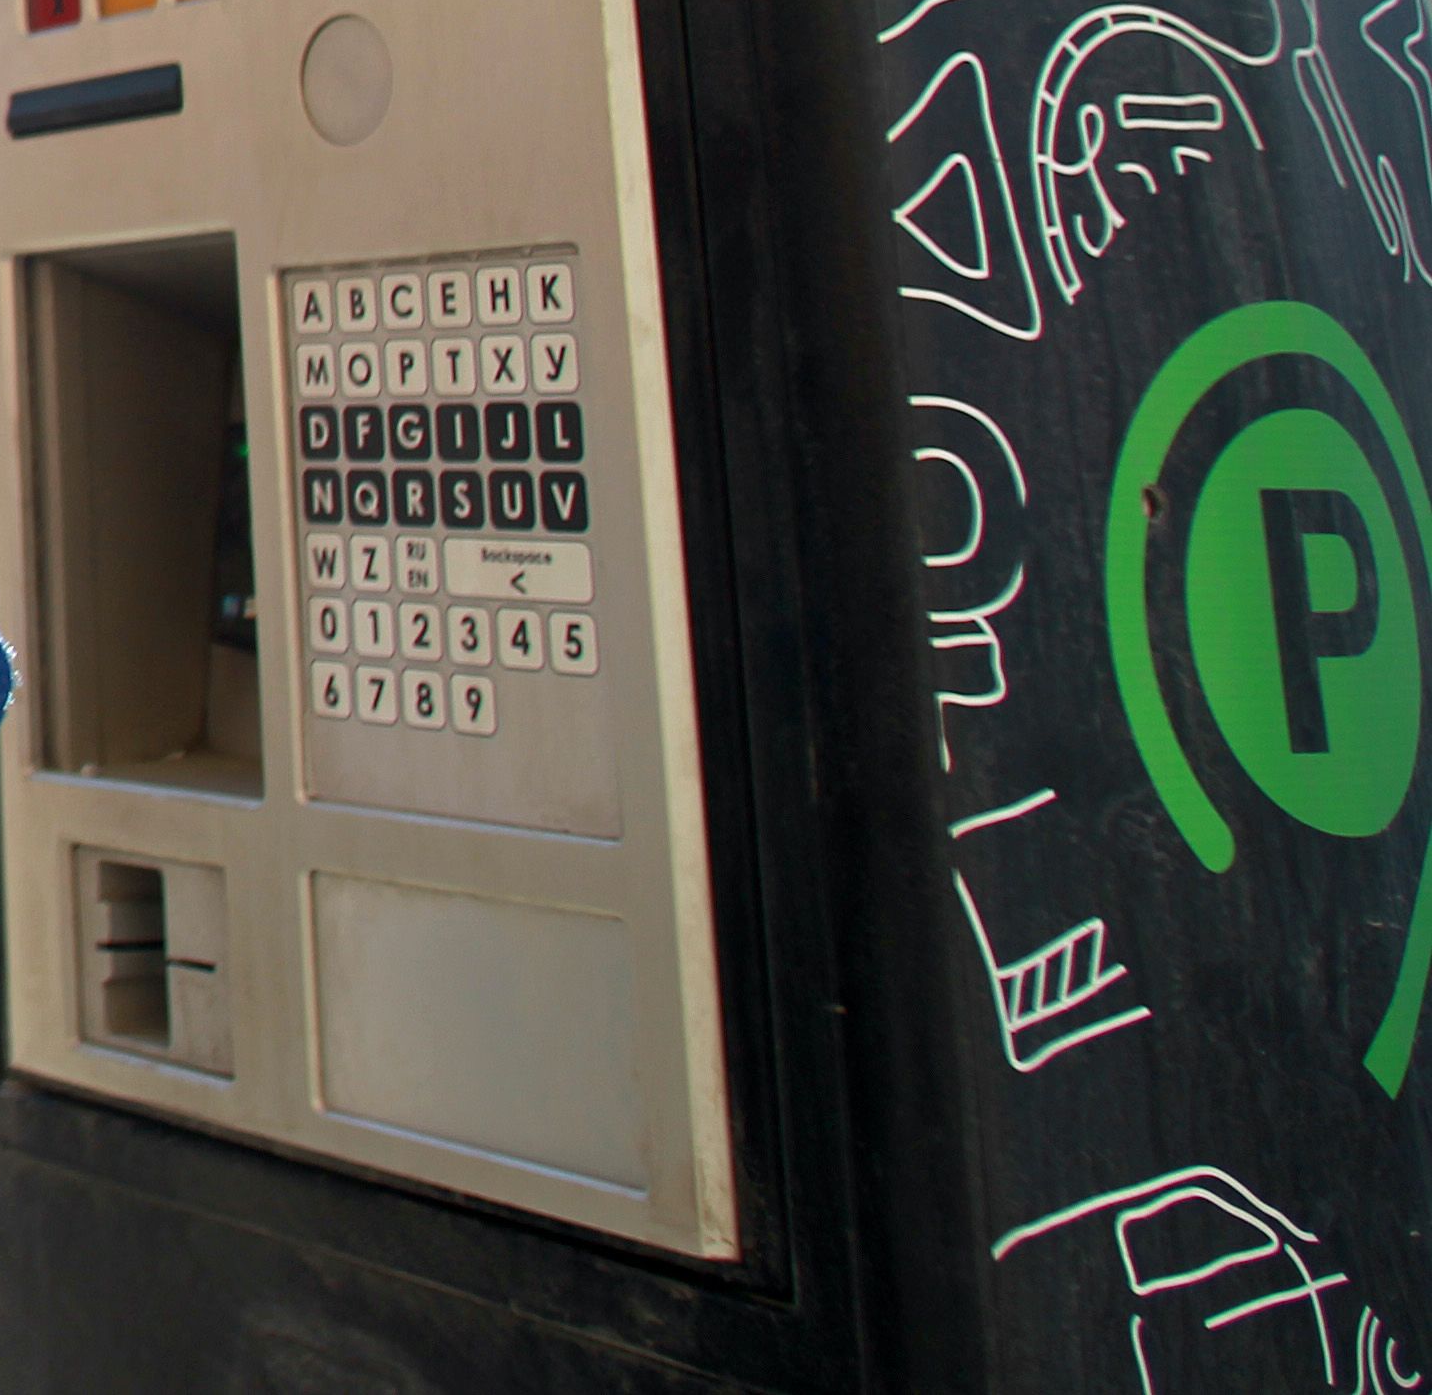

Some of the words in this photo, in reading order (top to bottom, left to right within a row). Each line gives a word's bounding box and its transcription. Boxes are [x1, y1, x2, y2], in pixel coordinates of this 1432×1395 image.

[303, 289, 323, 323] A
[350, 288, 365, 321] B
[390, 284, 413, 317] C
[441, 281, 456, 315] E
[490, 277, 510, 312] H
[541, 274, 560, 310] K
[306, 356, 329, 386] M
[348, 353, 372, 386] O
[400, 352, 414, 385] P
[446, 350, 460, 383] T
[493, 347, 515, 383] X
[310, 415, 328, 449] D
[357, 414, 369, 449] F
[397, 412, 423, 449] G
[501, 412, 514, 449] J
[555, 411, 570, 448] L
[312, 479, 333, 516] N
[354, 481, 379, 518] Q
[406, 480, 423, 517] R
[453, 480, 470, 518] S
[502, 483, 523, 520] U
[552, 482, 575, 520] V
[313, 549, 336, 578] W
[363, 547, 378, 580] Z
[406, 542, 426, 561] RU
[408, 569, 428, 588] EN
[320, 606, 336, 640] 0
[369, 610, 378, 645] 1
[412, 613, 430, 647] 2
[461, 616, 478, 652] 3
[511, 619, 529, 655] 4
[564, 623, 582, 660] 5
[1259, 488, 1380, 754] P
[325, 674, 338, 707] 6
[369, 678, 384, 711] 7
[417, 682, 433, 717] 8
[466, 687, 482, 721] 9
